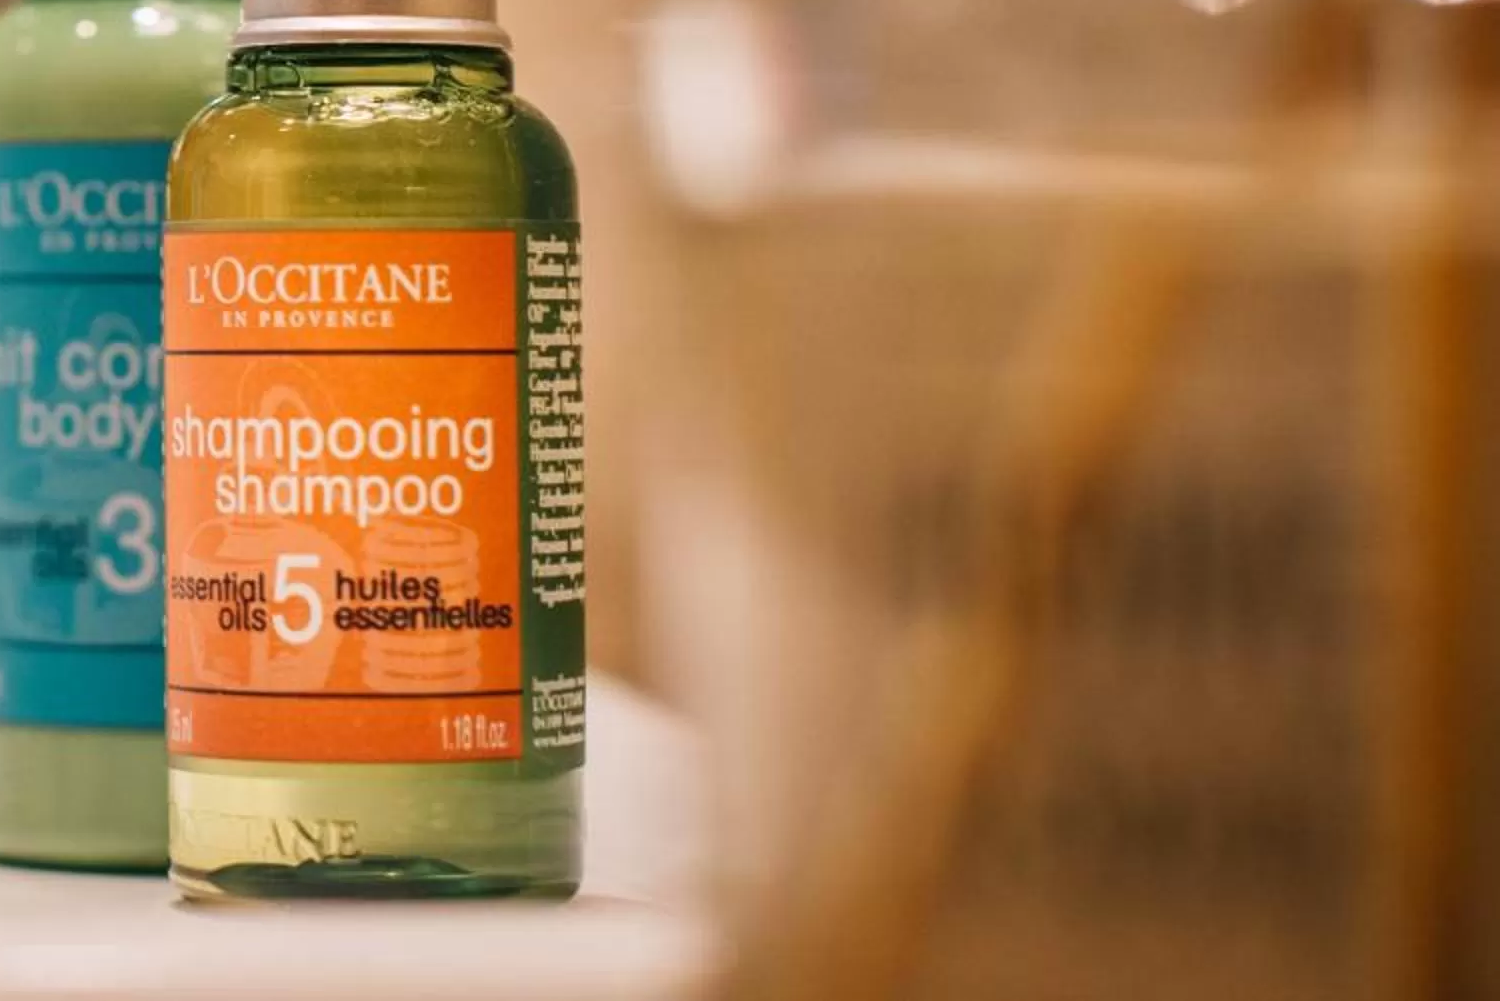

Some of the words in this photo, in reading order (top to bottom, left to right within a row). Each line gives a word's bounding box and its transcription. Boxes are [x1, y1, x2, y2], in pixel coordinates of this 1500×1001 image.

[187, 256, 453, 305] L'OCCITANE
[221, 310, 249, 328] EN
[259, 310, 395, 329] PROVENCE
[18, 391, 158, 463] body
[171, 404, 495, 472] shampooing
[214, 457, 463, 527] shampoo
[96, 490, 160, 593] 3
[171, 570, 266, 602] essential
[271, 553, 324, 645] 5
[334, 569, 441, 601] huiles
[218, 601, 267, 632] oils
[332, 598, 514, 632] essentielles
[439, 713, 473, 752] 1.18
